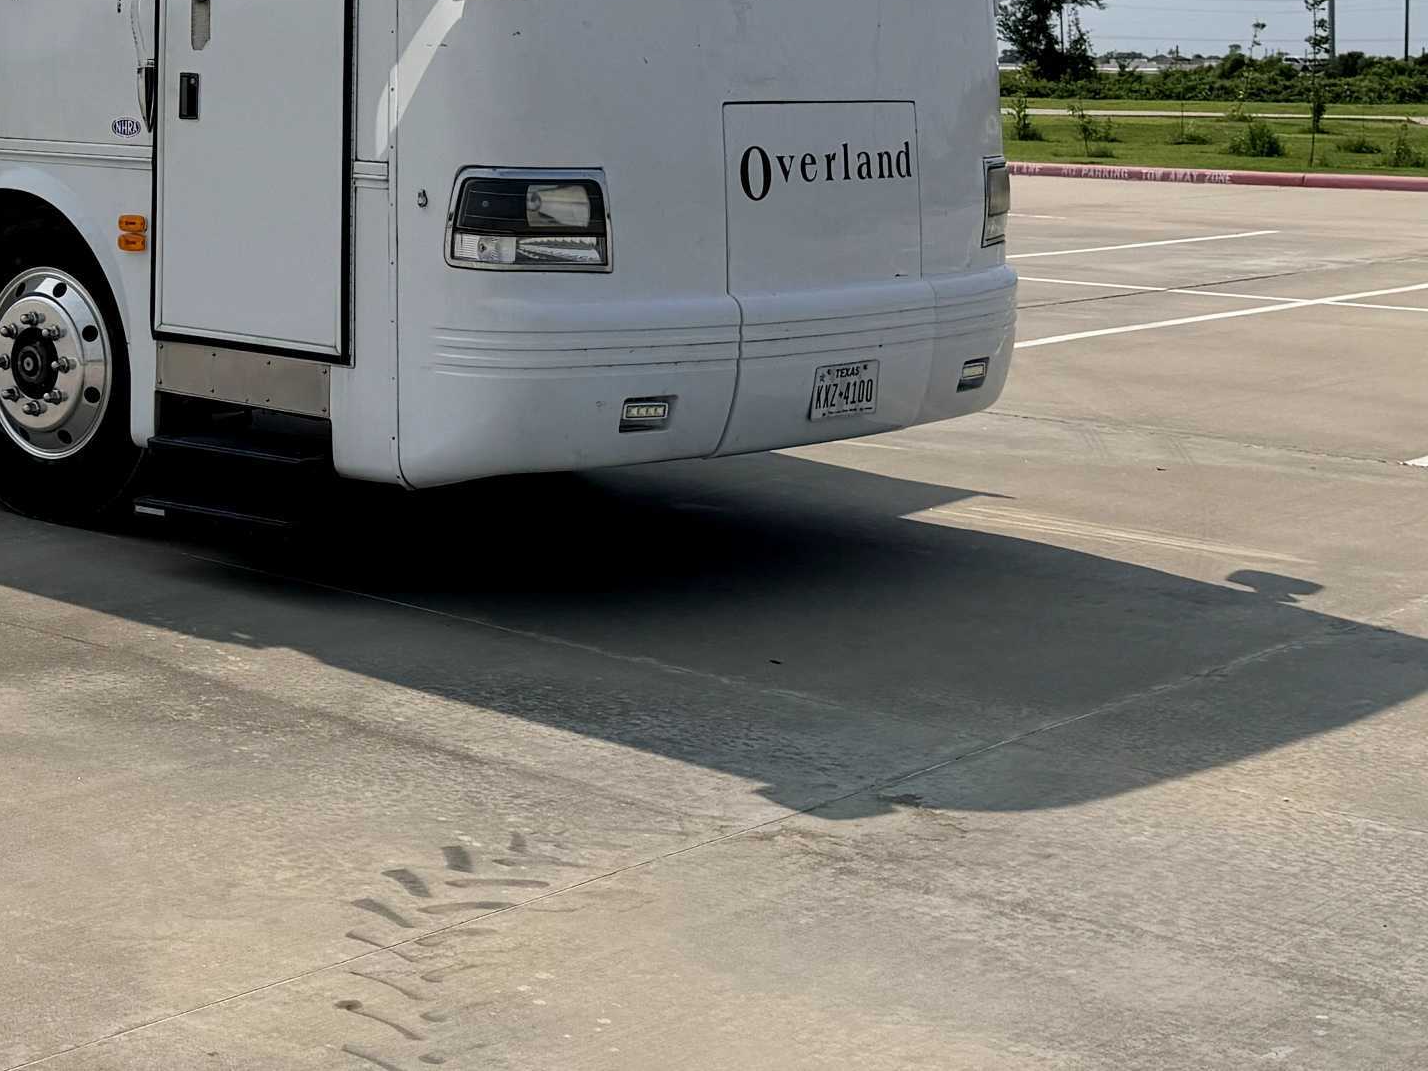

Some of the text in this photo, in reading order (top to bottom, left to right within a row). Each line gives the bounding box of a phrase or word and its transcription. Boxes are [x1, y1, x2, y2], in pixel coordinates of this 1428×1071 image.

[115, 119, 140, 135] NHRA
[740, 141, 912, 201] Overland
[1081, 167, 1129, 179] PARKING
[1141, 169, 1164, 181] TOW
[1169, 170, 1197, 183] AWAY
[1204, 171, 1231, 184] ZONE
[836, 366, 860, 378] TEXAS
